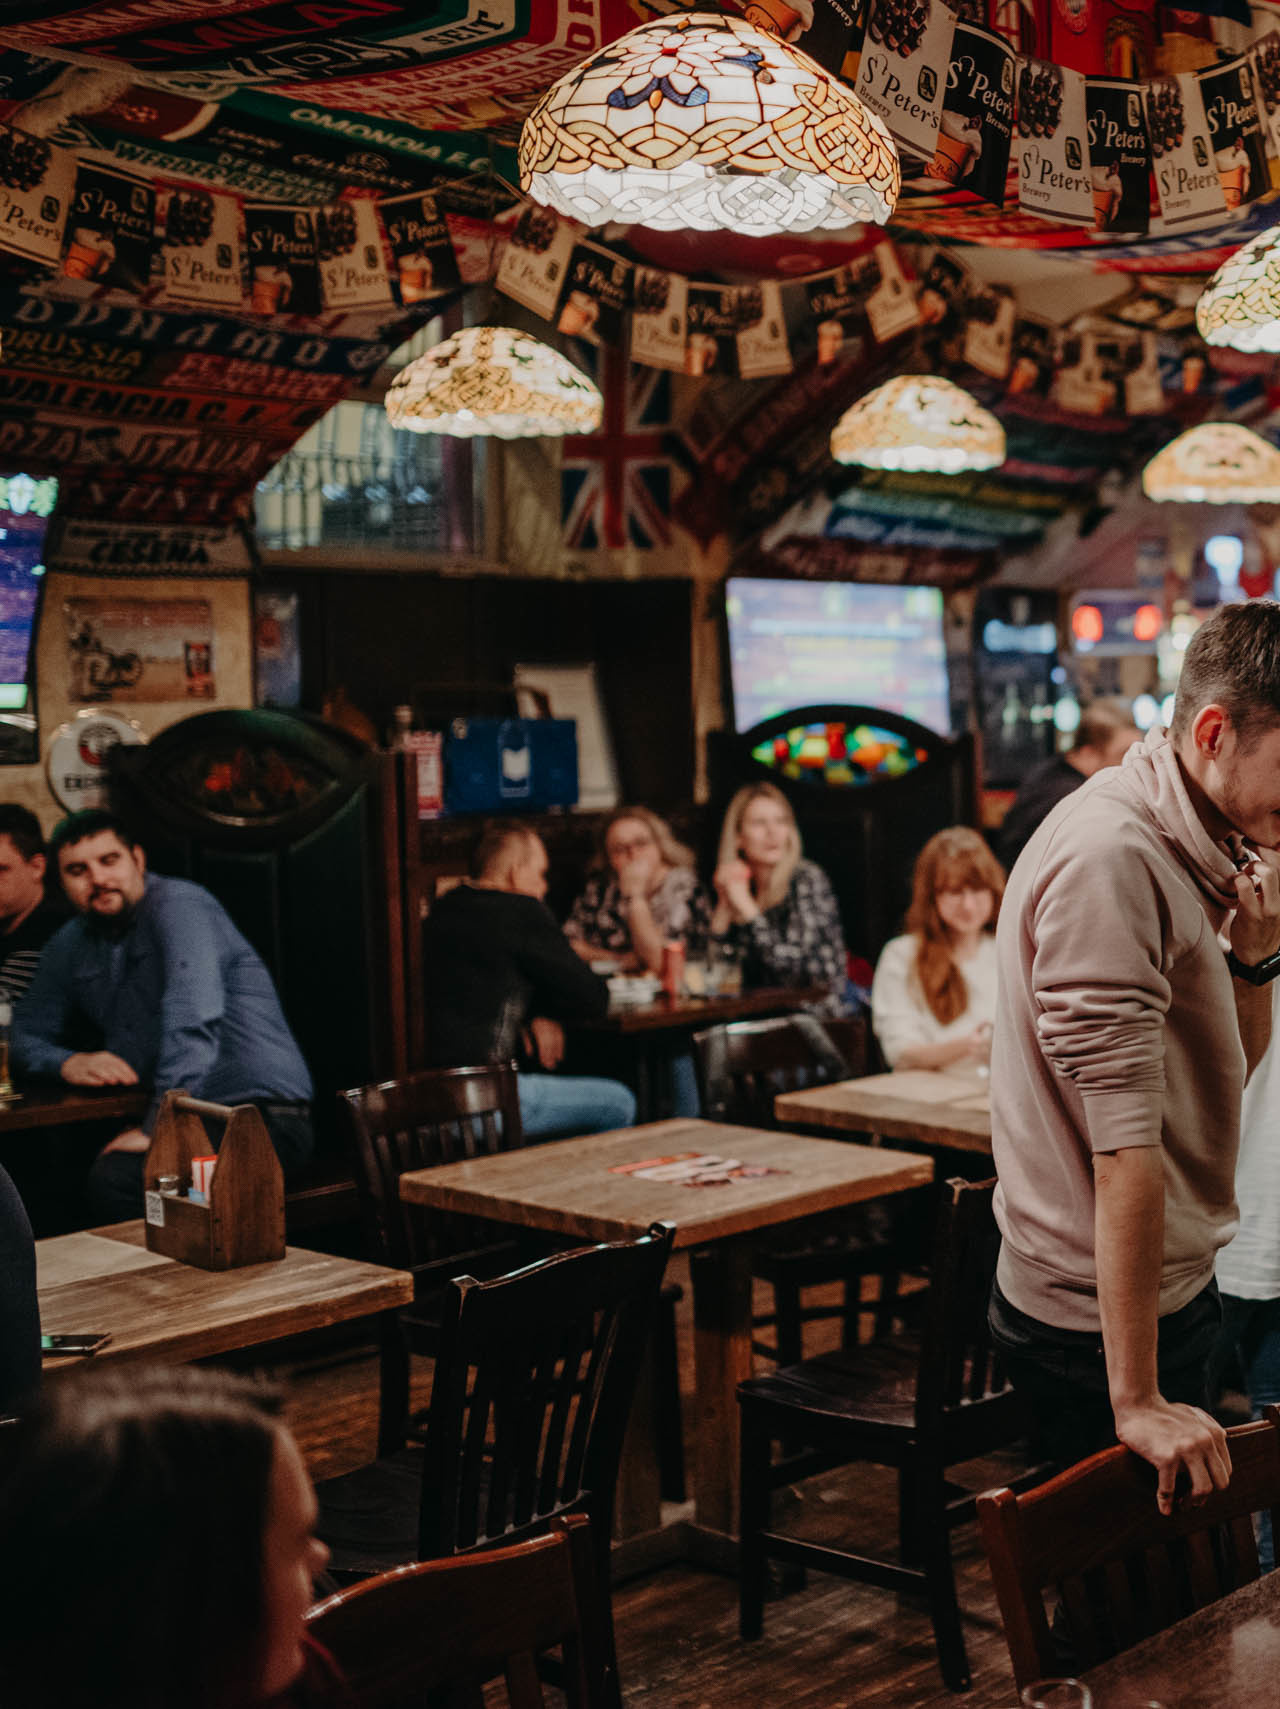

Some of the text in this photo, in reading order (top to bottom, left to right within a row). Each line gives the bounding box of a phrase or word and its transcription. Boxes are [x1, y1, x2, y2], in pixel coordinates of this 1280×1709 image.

[423, 10, 503, 46] SEIT
[858, 85, 892, 118] Brewery
[881, 73, 940, 129] Peter's
[967, 71, 1015, 120] Peter's
[984, 111, 1012, 140] Brewery
[1104, 121, 1147, 150] Peter's
[1120, 154, 1148, 168] Brewery
[1040, 158, 1091, 194] Peter's
[1177, 166, 1221, 194] Peter's
[1022, 182, 1051, 202] Brewery
[7, 206, 61, 242] Peter's
[100, 199, 151, 229] Peter's
[192, 261, 241, 286] Peter's
[91, 537, 208, 564] CESENA
